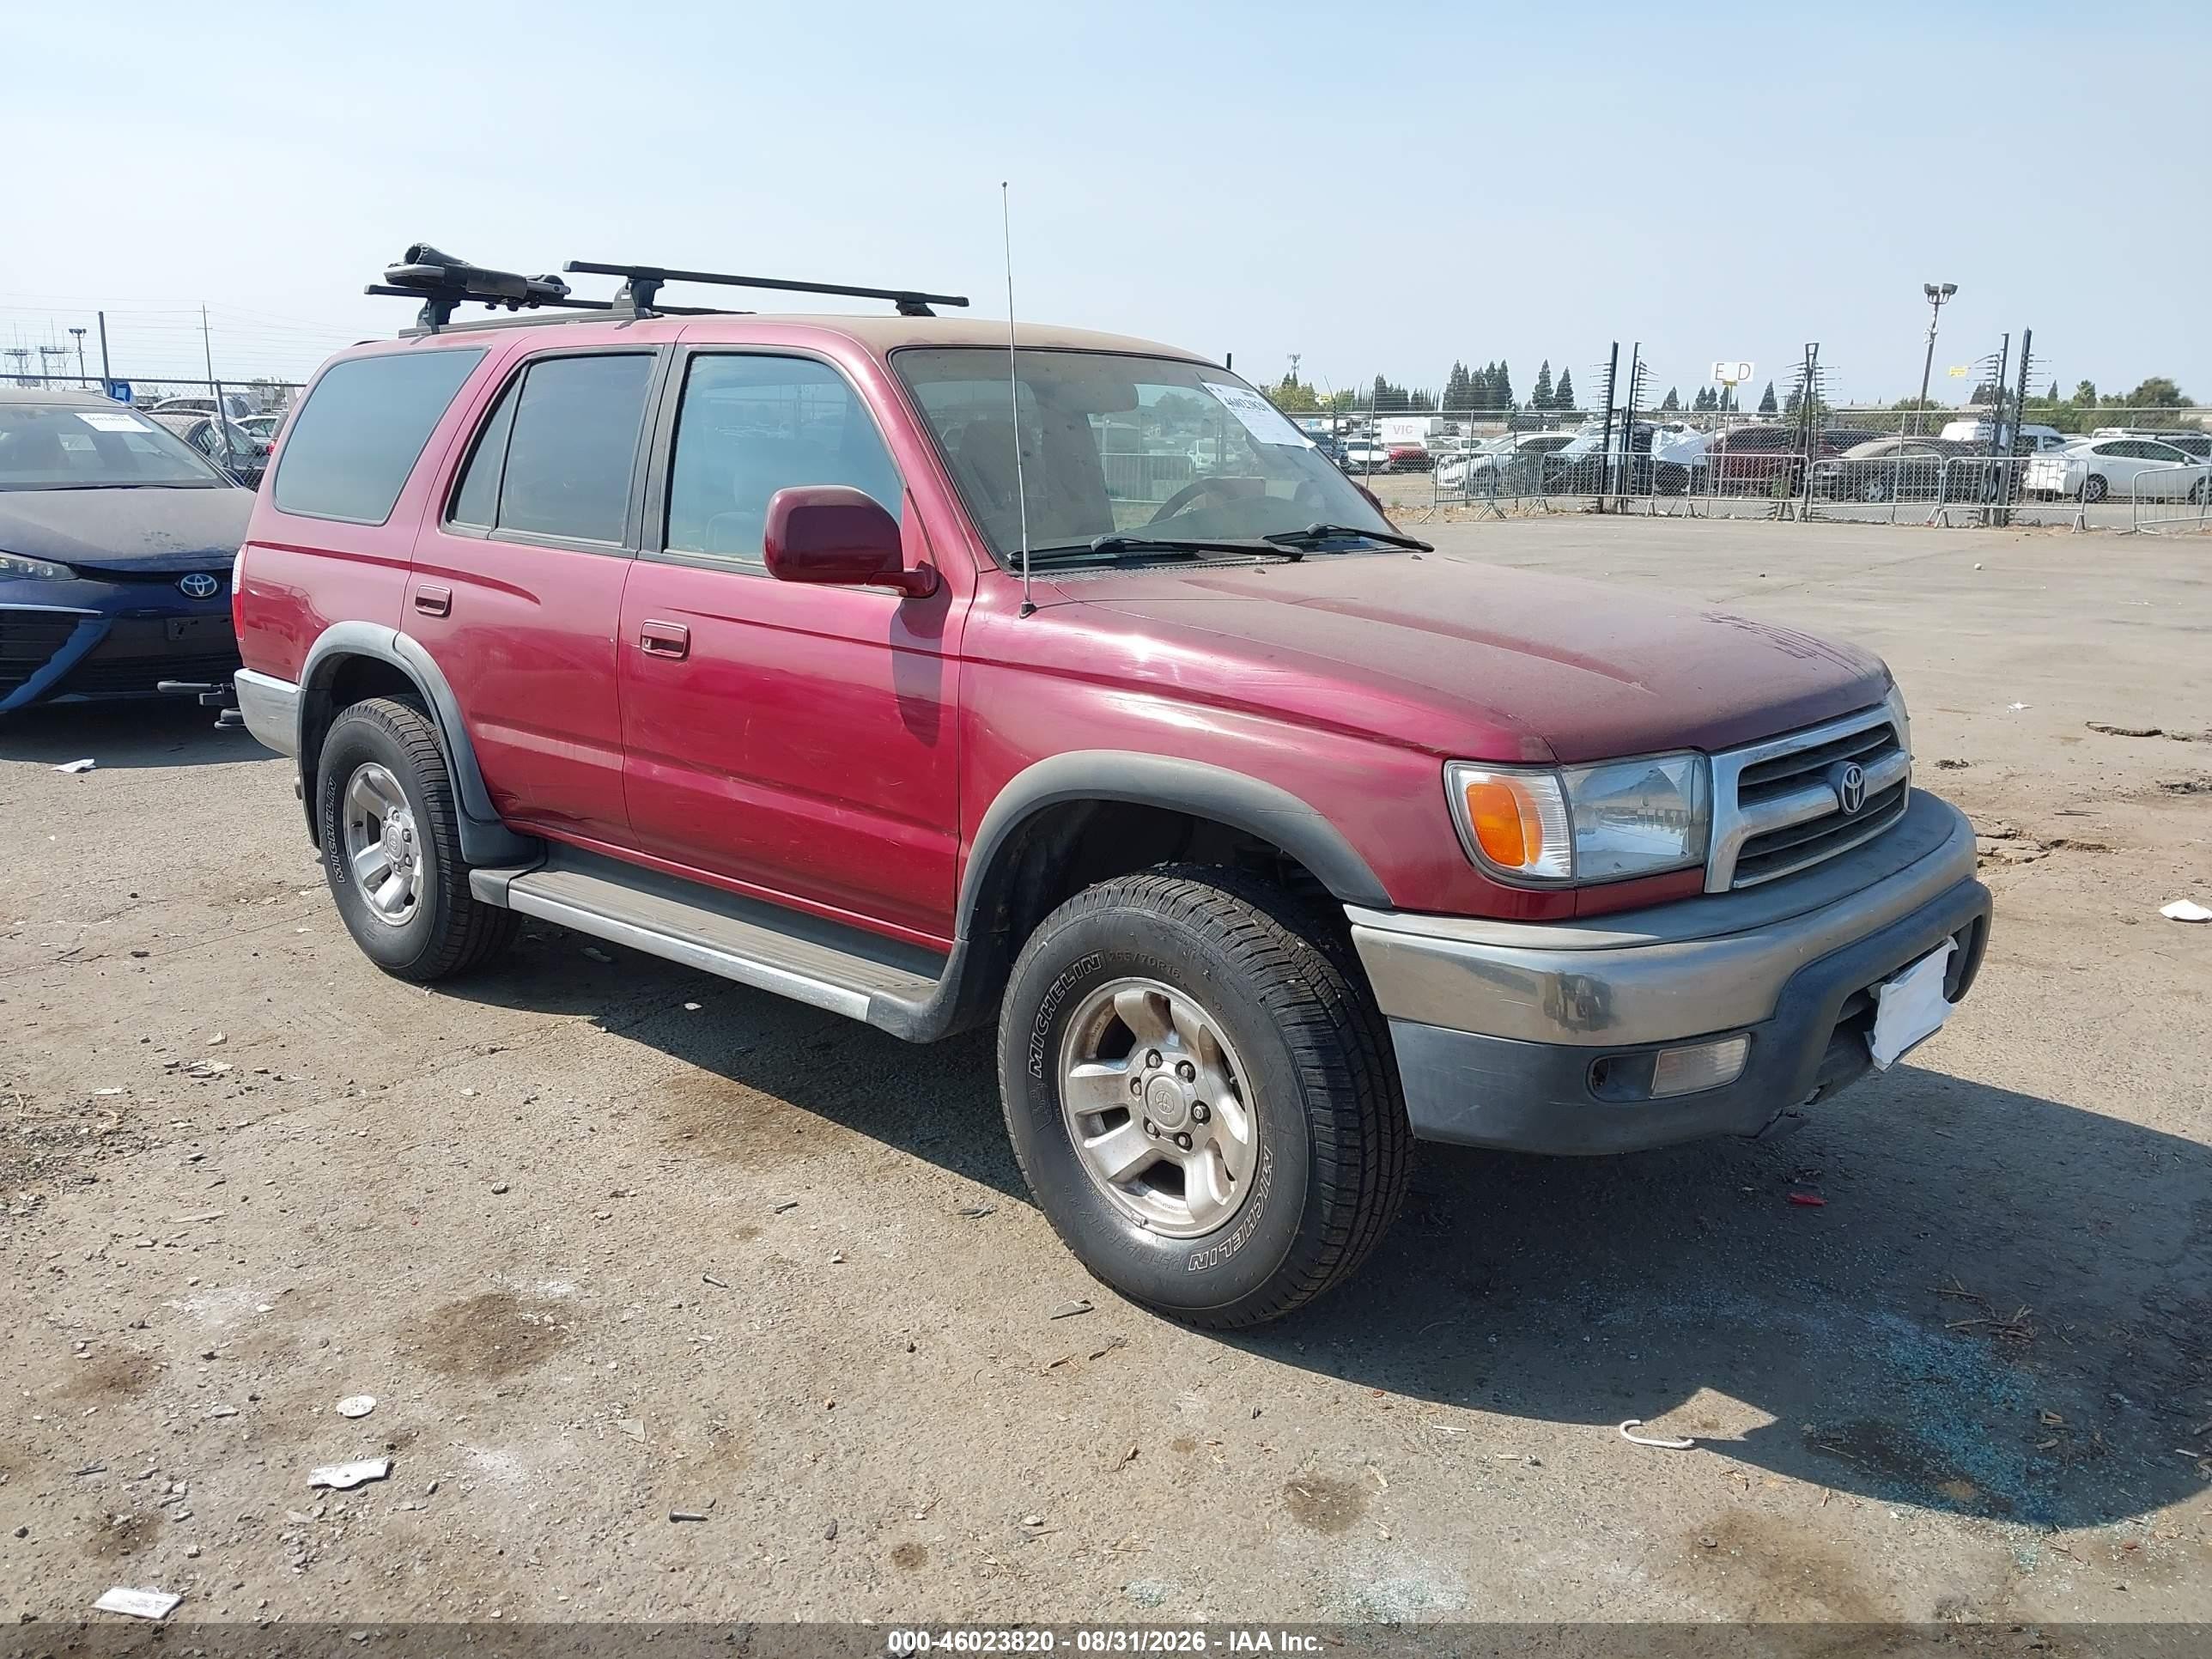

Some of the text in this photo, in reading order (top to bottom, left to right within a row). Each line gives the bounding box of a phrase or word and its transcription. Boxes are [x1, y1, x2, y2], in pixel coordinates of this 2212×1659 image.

[1715, 362, 1751, 380] E D
[1393, 425, 1413, 434] VIC
[325, 776, 345, 883] MICHELIN
[1029, 953, 1103, 1079] MICHELIN
[1188, 1145, 1274, 1272] MICHELIN
